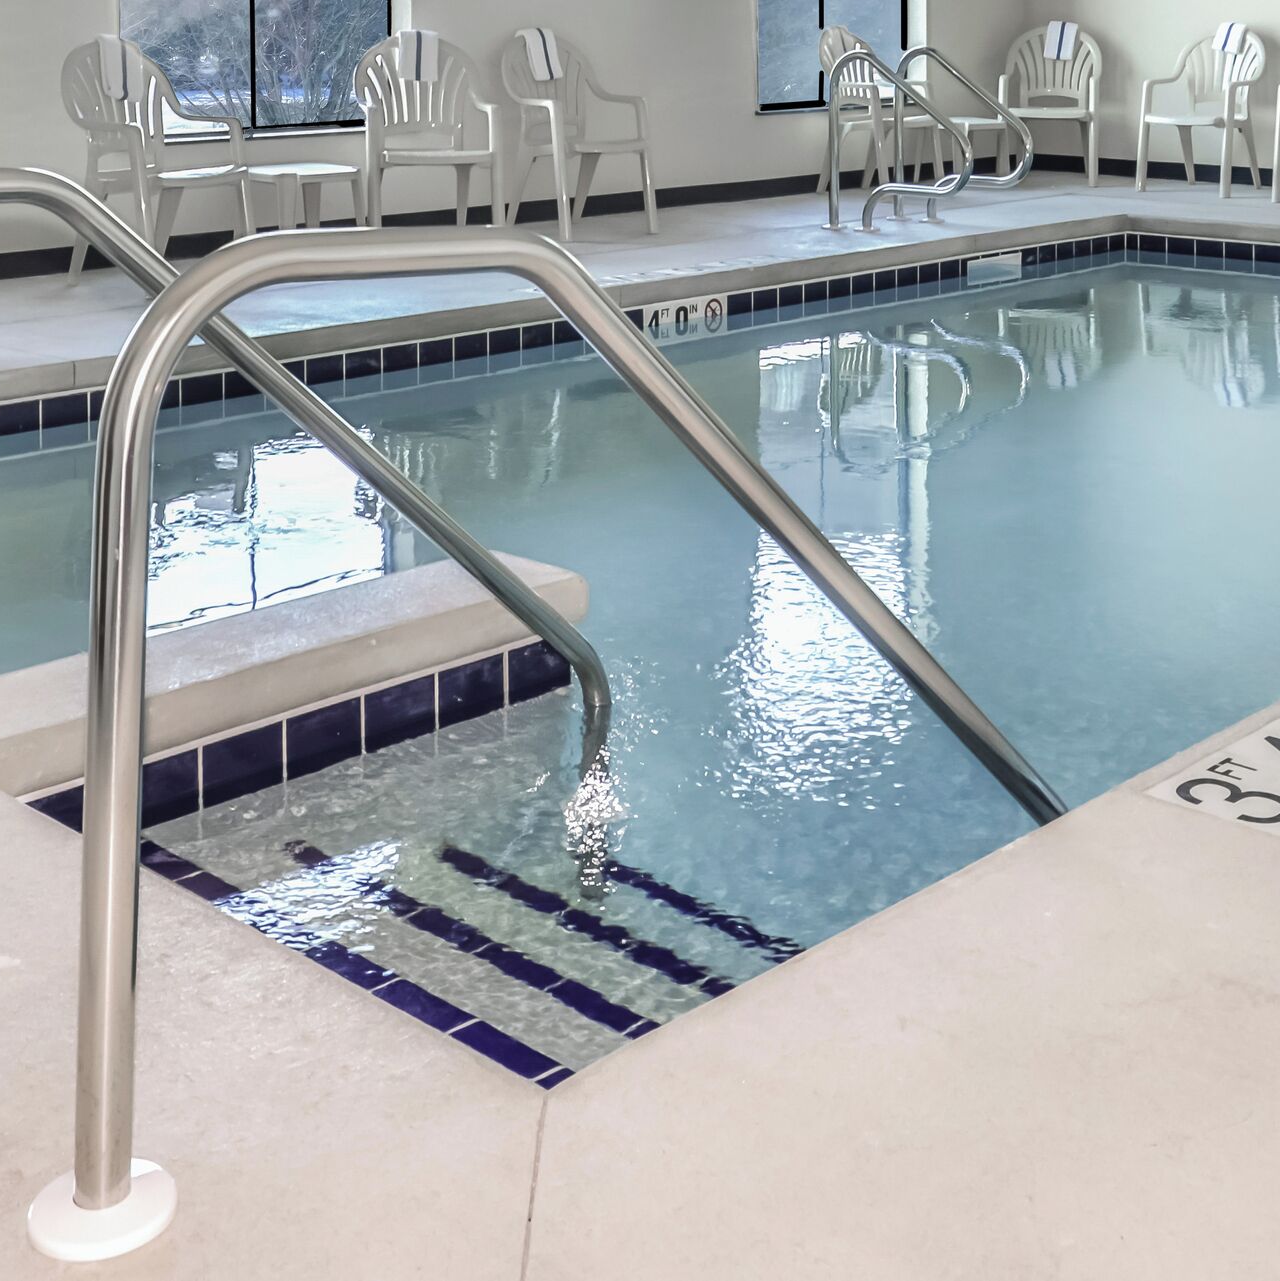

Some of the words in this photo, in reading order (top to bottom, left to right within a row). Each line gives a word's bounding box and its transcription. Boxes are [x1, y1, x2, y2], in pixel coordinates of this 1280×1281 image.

[661, 308, 670, 318] FT
[689, 304, 698, 314] IN
[1206, 757, 1258, 780] FT
